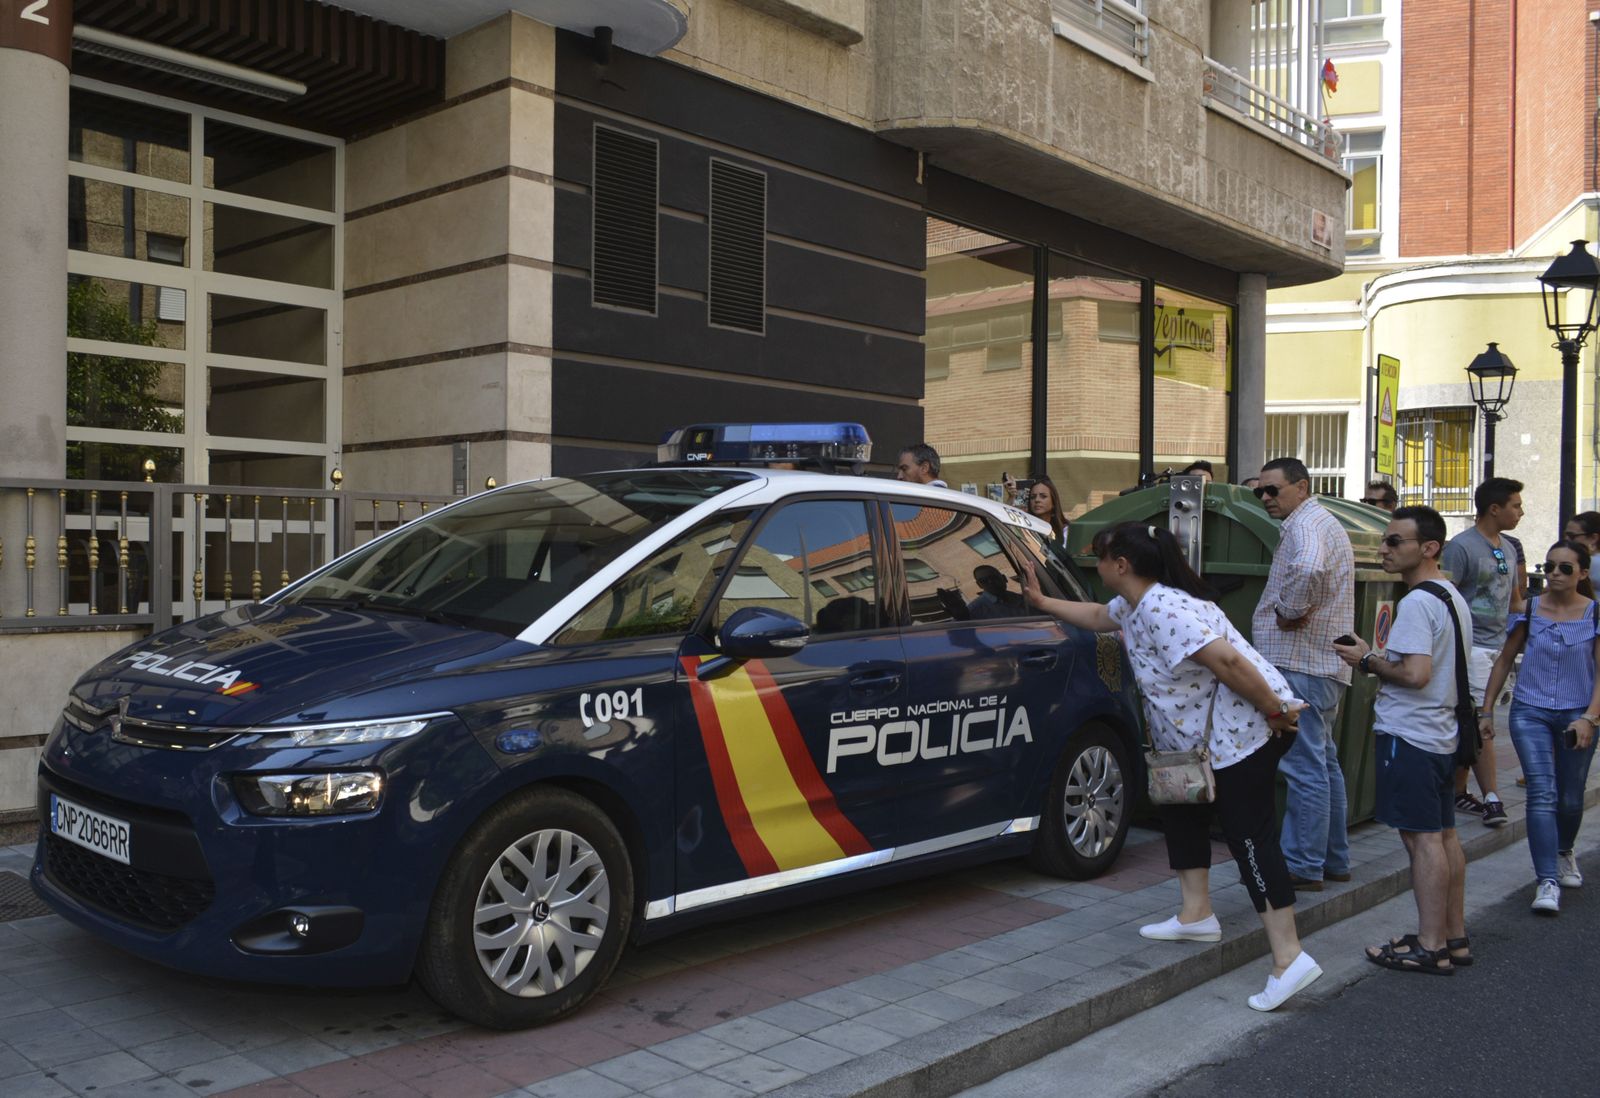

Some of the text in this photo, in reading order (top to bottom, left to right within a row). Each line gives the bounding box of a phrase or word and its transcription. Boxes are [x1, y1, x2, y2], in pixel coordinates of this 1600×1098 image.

[687, 453, 707, 461] CNP
[595, 687, 644, 723] 091
[830, 695, 998, 724] CUERPO NACIONAL DE
[826, 696, 1033, 774] POLICÍA
